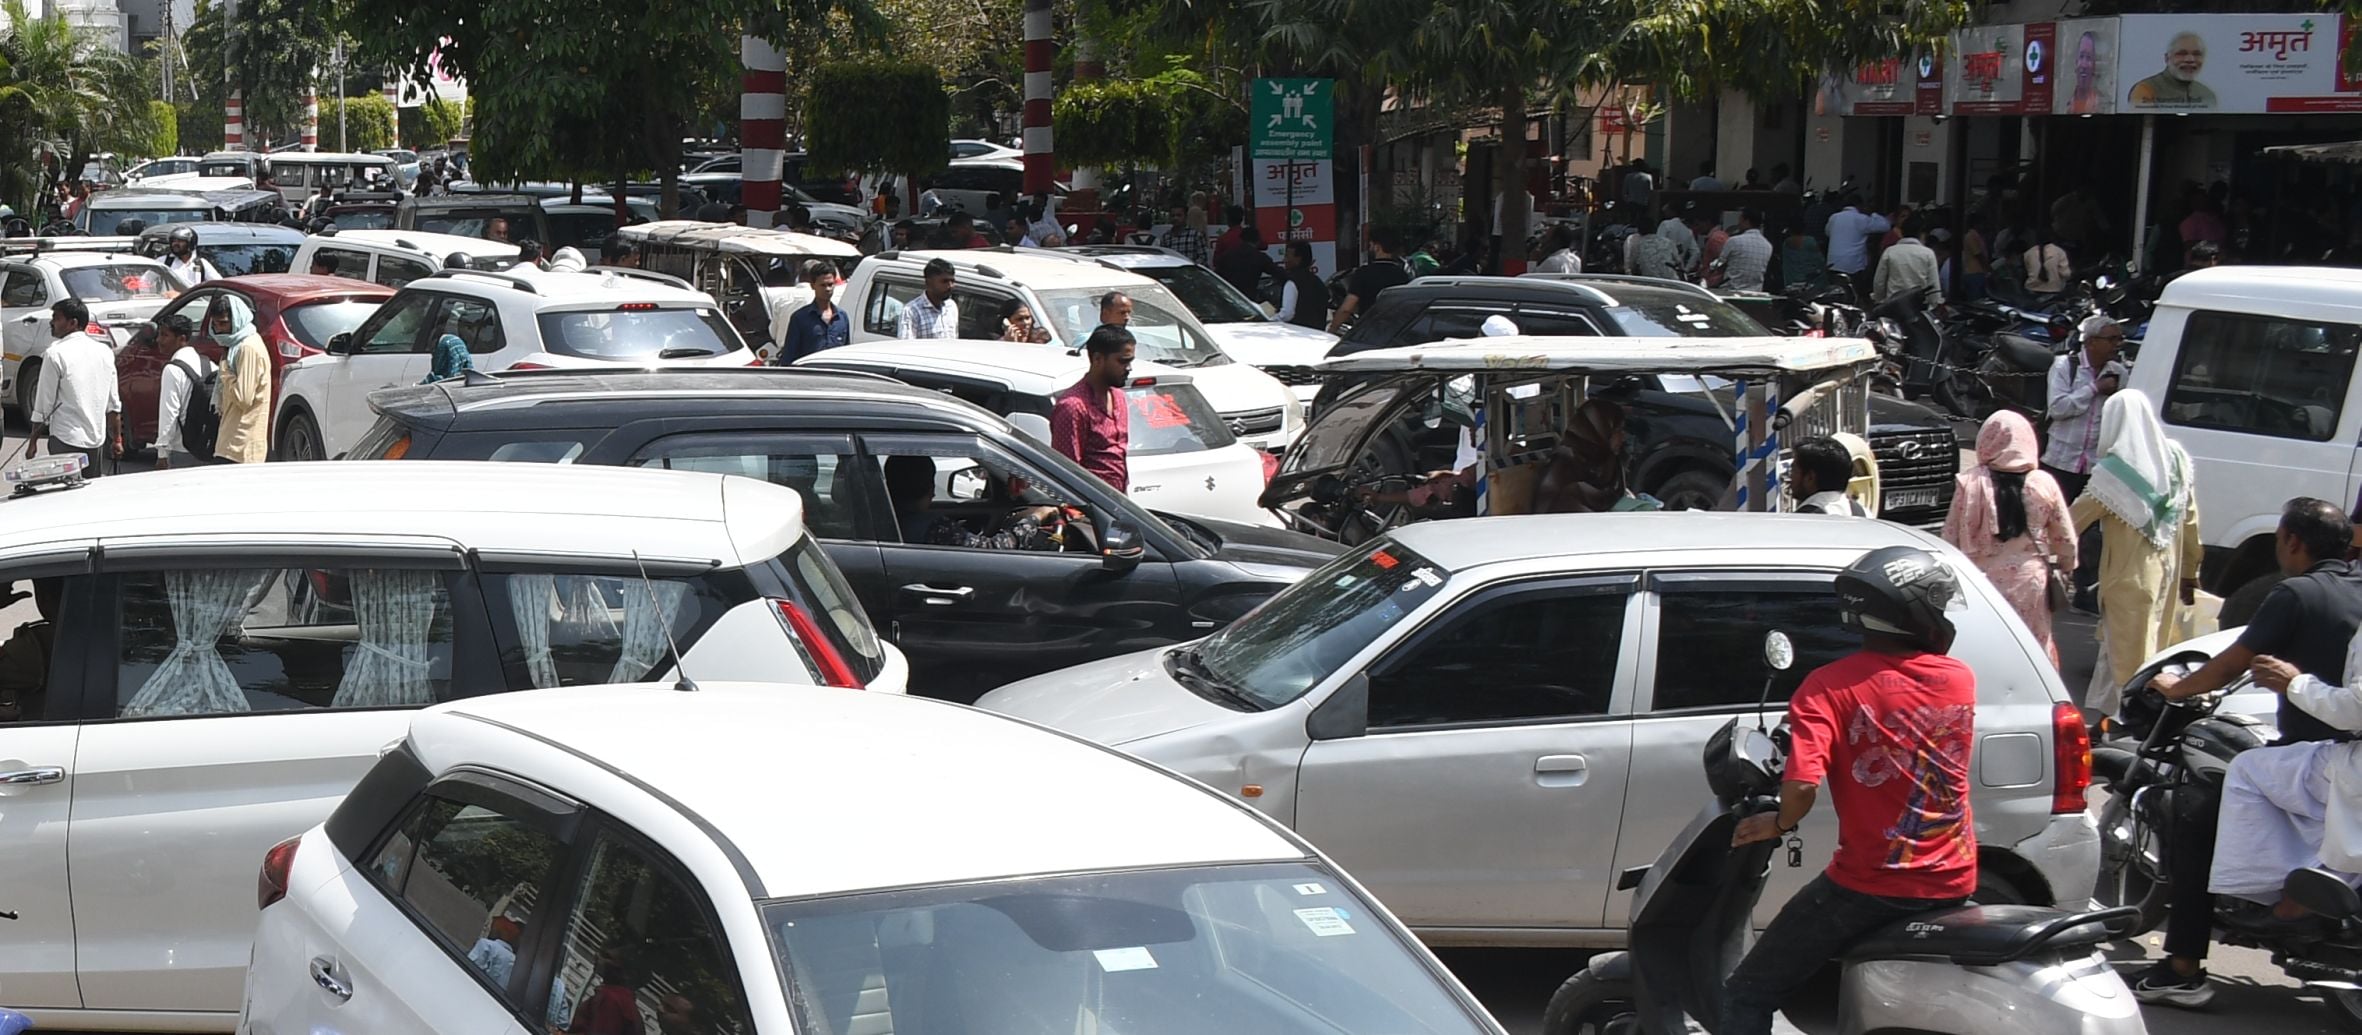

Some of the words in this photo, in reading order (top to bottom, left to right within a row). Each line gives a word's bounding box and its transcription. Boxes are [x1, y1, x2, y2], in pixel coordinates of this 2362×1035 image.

[2239, 31, 2313, 61] अमृत
[1268, 129, 1315, 139] Emergency
[1260, 140, 1299, 148] assembly
[1300, 140, 1322, 148] point
